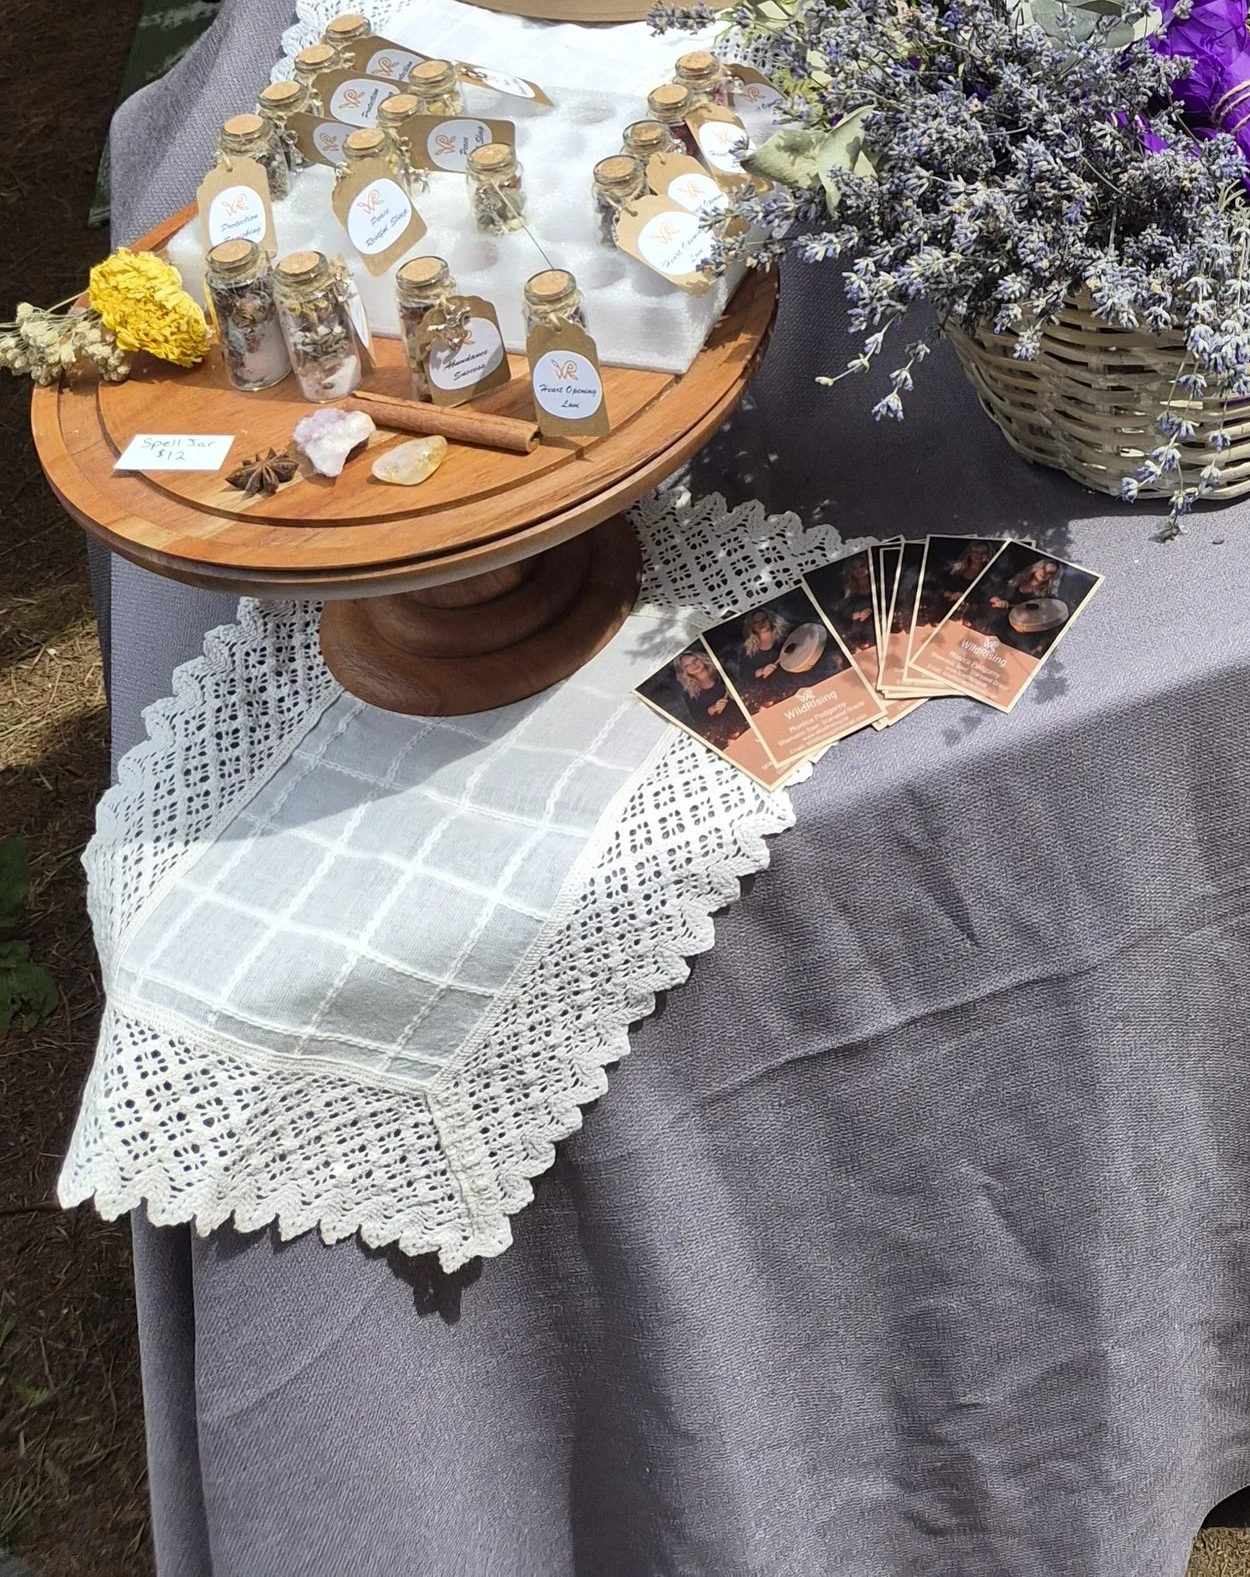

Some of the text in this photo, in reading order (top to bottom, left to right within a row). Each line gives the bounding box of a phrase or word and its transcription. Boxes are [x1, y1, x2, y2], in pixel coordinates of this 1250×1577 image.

[443, 348, 488, 371] Abundance
[539, 383, 597, 397] Heart Opening
[140, 438, 217, 451] Spell Jar
[156, 449, 186, 461] $12
[961, 639, 1008, 668] WildRising
[783, 690, 838, 720] WildRising
